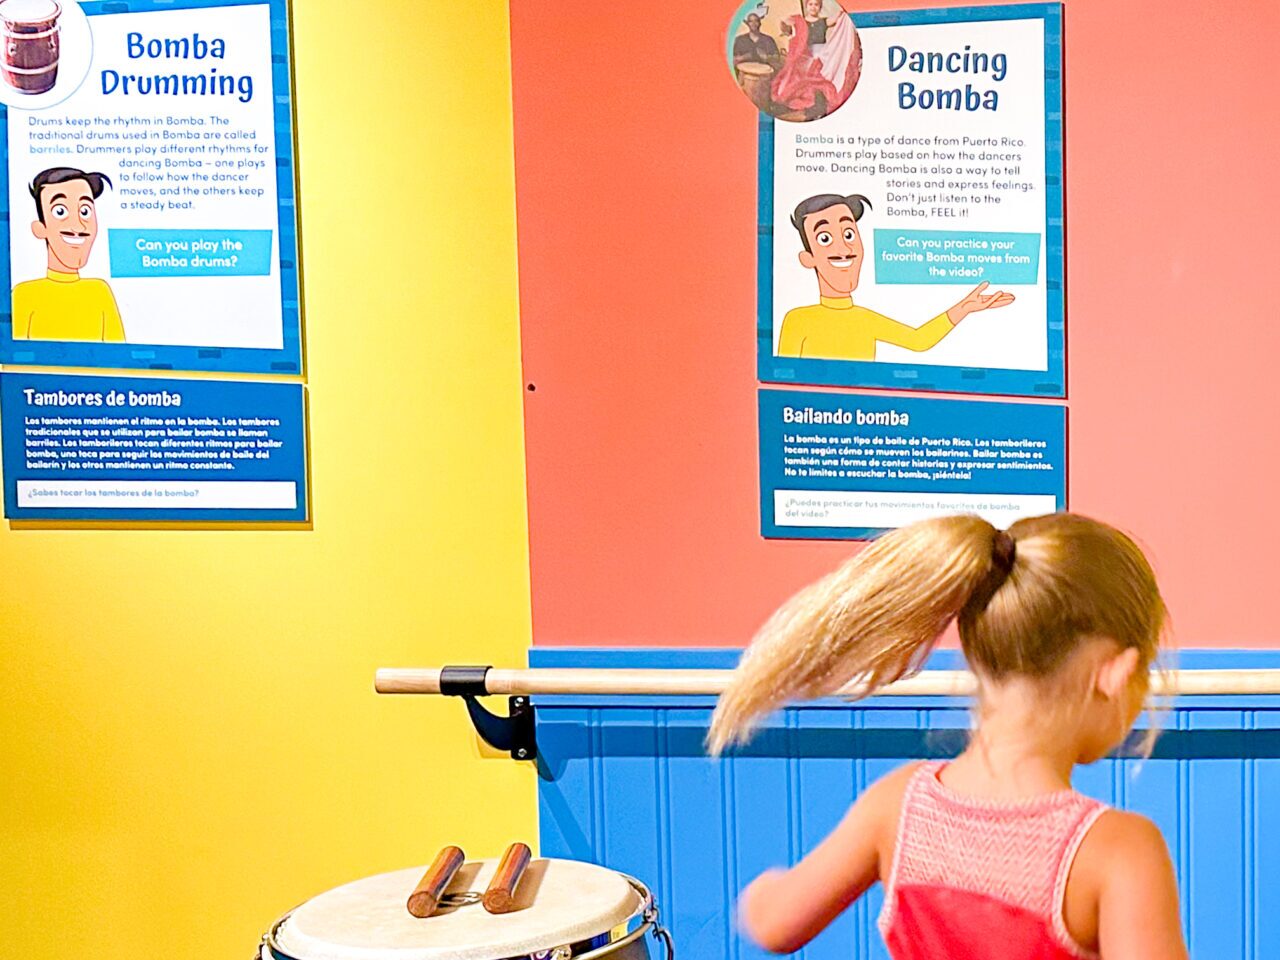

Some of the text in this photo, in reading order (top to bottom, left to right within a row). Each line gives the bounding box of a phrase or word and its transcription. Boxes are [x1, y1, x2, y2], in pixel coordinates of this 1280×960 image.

[126, 32, 225, 59] Bomba
[888, 43, 1007, 81] Dancing
[100, 66, 253, 102] Drumming
[898, 81, 998, 112] Bomba
[28, 116, 62, 125] Drums
[65, 116, 91, 127] keep
[93, 116, 110, 125] the
[113, 115, 150, 127] rhythm
[166, 115, 206, 125] Bomba.
[209, 115, 229, 125] The
[28, 130, 83, 139] traditional
[85, 130, 119, 139] drums
[121, 130, 147, 139] used
[162, 129, 200, 139] Bomba
[223, 130, 256, 139] called
[795, 134, 833, 143] Bomba
[857, 135, 881, 147] type
[883, 134, 894, 144] of
[897, 135, 930, 145] dance
[933, 135, 959, 145] from
[962, 136, 997, 146] Puerto
[1000, 136, 1027, 146] Rico.
[29, 143, 268, 155] barriles. Drummers play different rhythms for
[795, 148, 851, 158] Drummers
[854, 149, 877, 161] play
[880, 149, 913, 159] based
[932, 150, 955, 160] how
[958, 151, 975, 160] the
[978, 151, 1021, 160] dancers
[886, 178, 1036, 192] stories and express feelings.
[886, 206, 968, 217] Bomba, FEEL it!
[135, 238, 242, 253] Can you play the
[896, 236, 1014, 251] Can you practice your
[142, 255, 238, 267] Bomba drums?
[881, 250, 1030, 263] favorite Bomba moves from
[928, 266, 984, 276] the video?
[23, 388, 181, 406] Tambores de bomba
[783, 406, 908, 426] Bailando bomba
[25, 438, 282, 449] barriles. Los tamborileros tocan diferentes ritmos para bailar
[784, 456, 820, 465] también
[840, 457, 867, 466] forma
[868, 457, 880, 466] de
[881, 459, 910, 467] contar
[911, 458, 948, 468] historias
[949, 461, 955, 470] y
[956, 461, 995, 470] expresar
[996, 460, 1053, 469] sentimientos.
